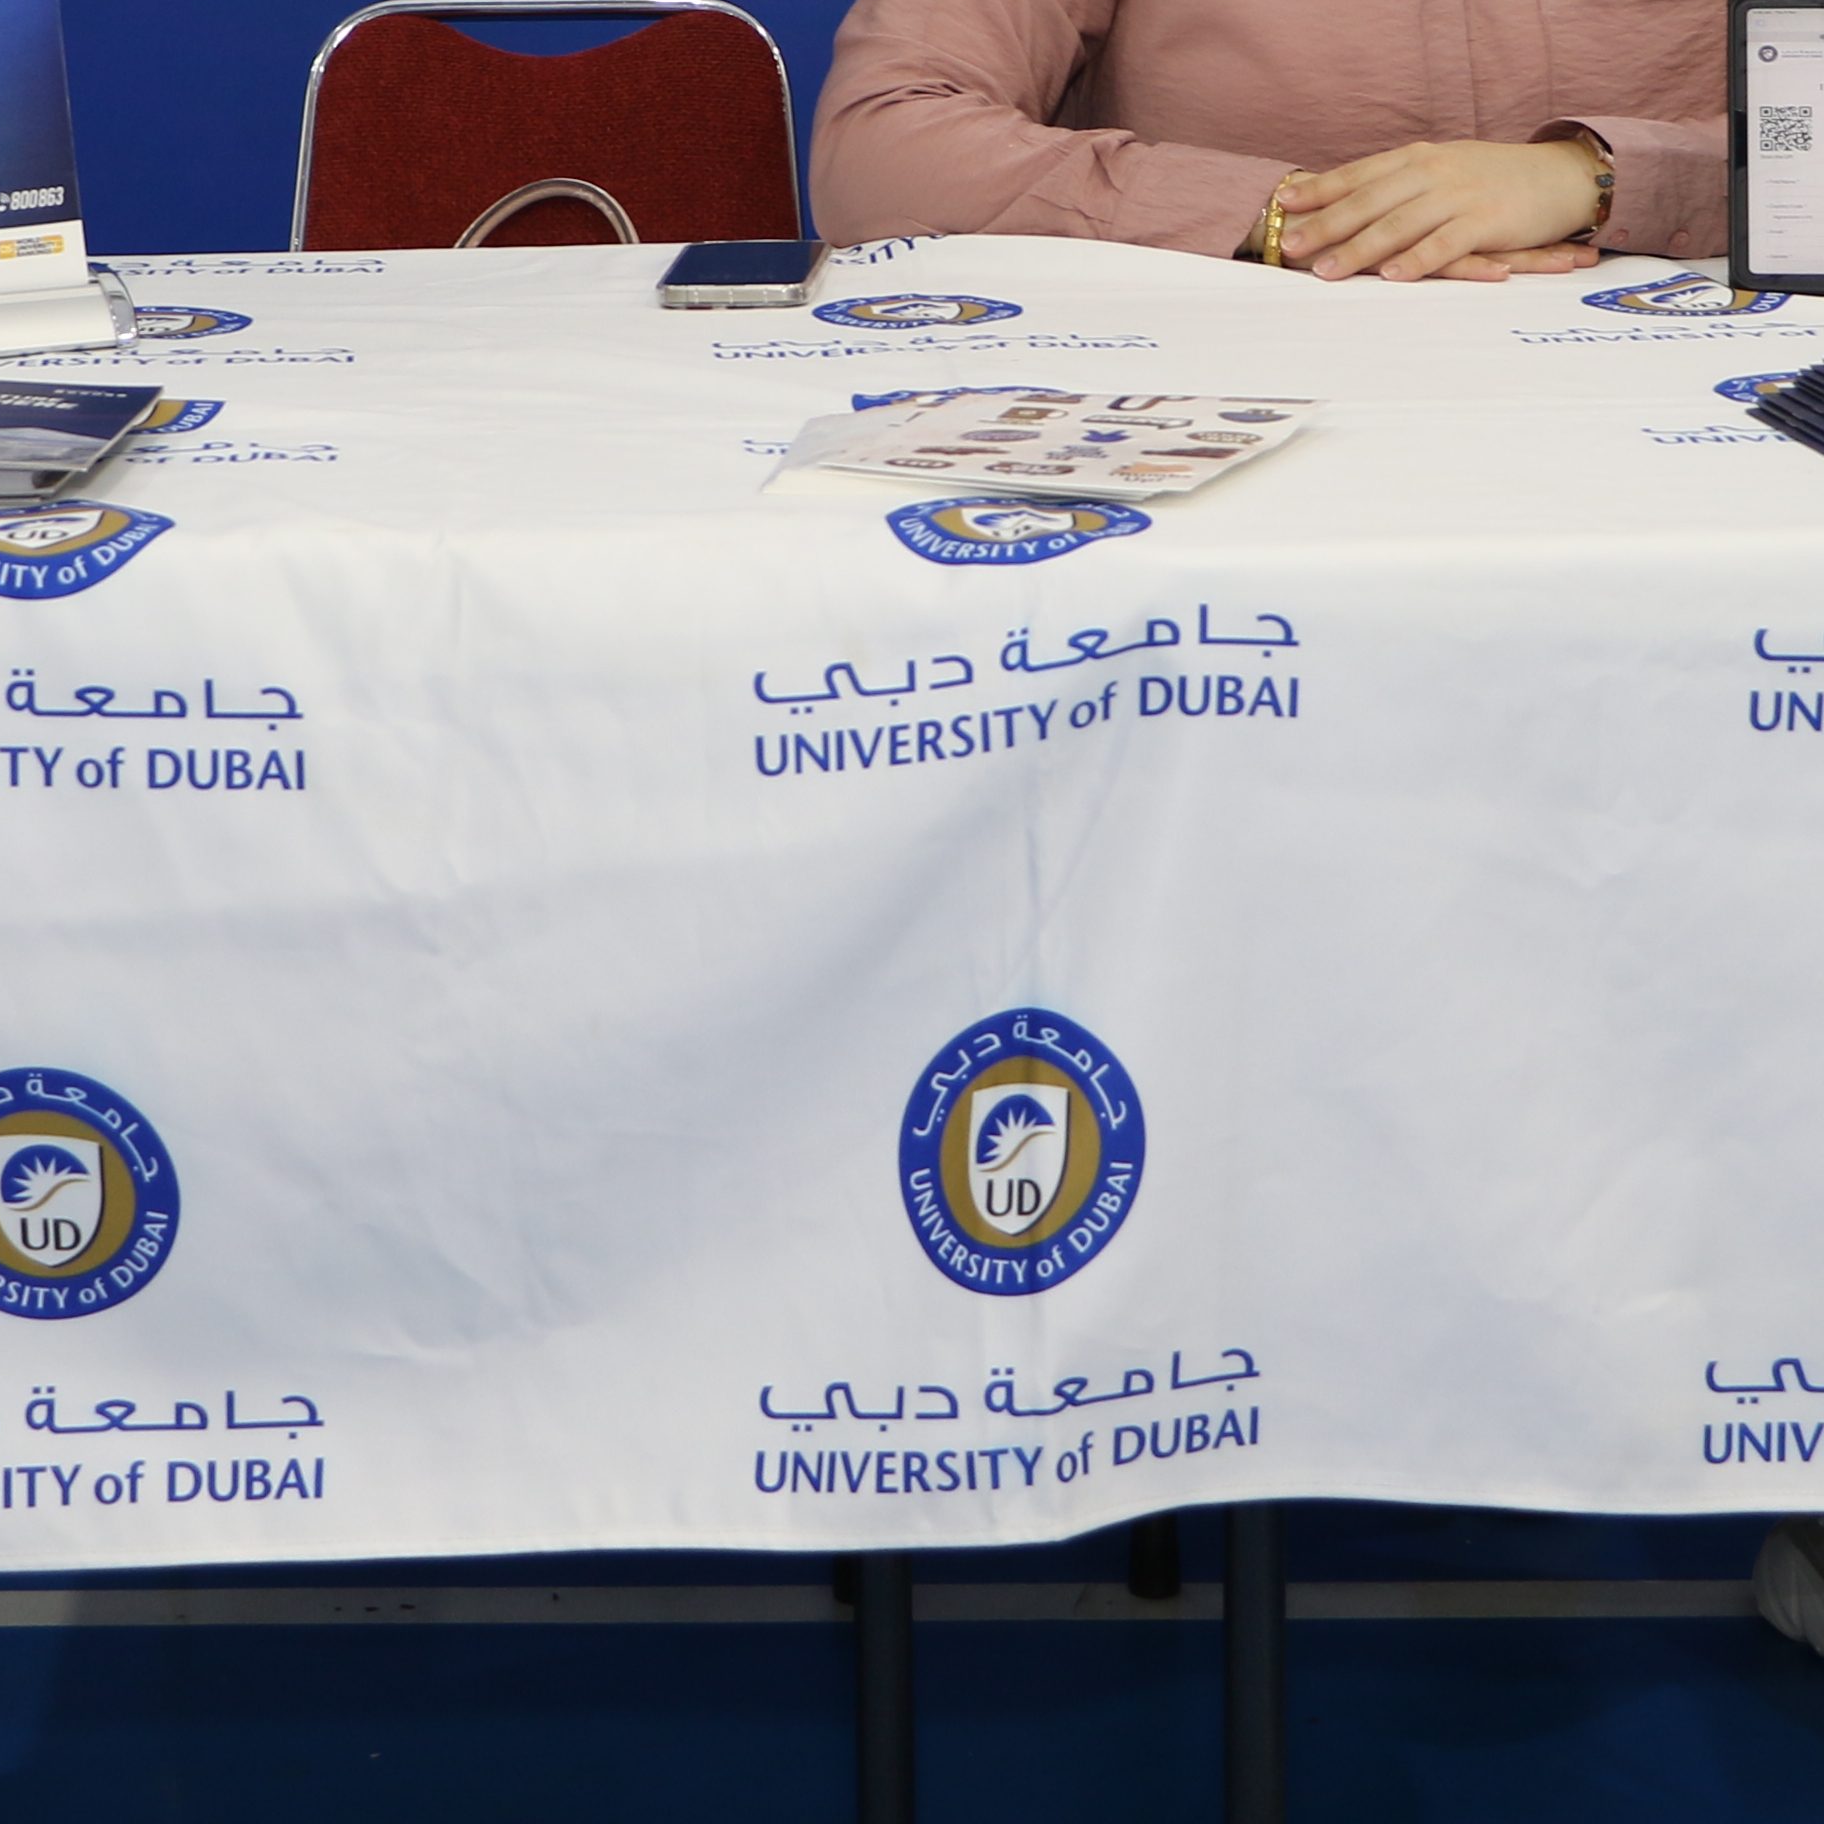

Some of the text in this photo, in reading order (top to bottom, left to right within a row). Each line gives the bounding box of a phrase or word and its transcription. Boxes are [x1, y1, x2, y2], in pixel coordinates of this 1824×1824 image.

[10, 186, 65, 210] 800863
[225, 355, 356, 365] DUBAI
[1520, 330, 1766, 344] UNIVERSITY
[57, 555, 88, 584] of
[91, 522, 159, 566] DUBAI
[899, 519, 1040, 559] UNIVERSITY
[754, 603, 1299, 714] جامعة دبي
[6, 669, 303, 730] جامعة
[755, 676, 1299, 777] UNIVERSITY of DUBAI
[77, 747, 125, 789] of
[147, 749, 306, 790] DUBAI
[913, 1015, 1126, 1136] جامعة دبي
[27, 1073, 158, 1182] جامعة
[910, 1161, 1133, 1283] UNIVERSITY of DUBAI
[985, 1178, 1041, 1216] UD
[19, 1218, 81, 1251] UD
[79, 1279, 108, 1304] of
[111, 1211, 169, 1287] DUBAI
[25, 1386, 325, 1439] جامعة
[760, 1347, 1260, 1432] جامعة دبي
[754, 1406, 1260, 1493] UNIVERSITY of DUBAI
[94, 1461, 145, 1504] of
[167, 1458, 325, 1503] DUBAI
